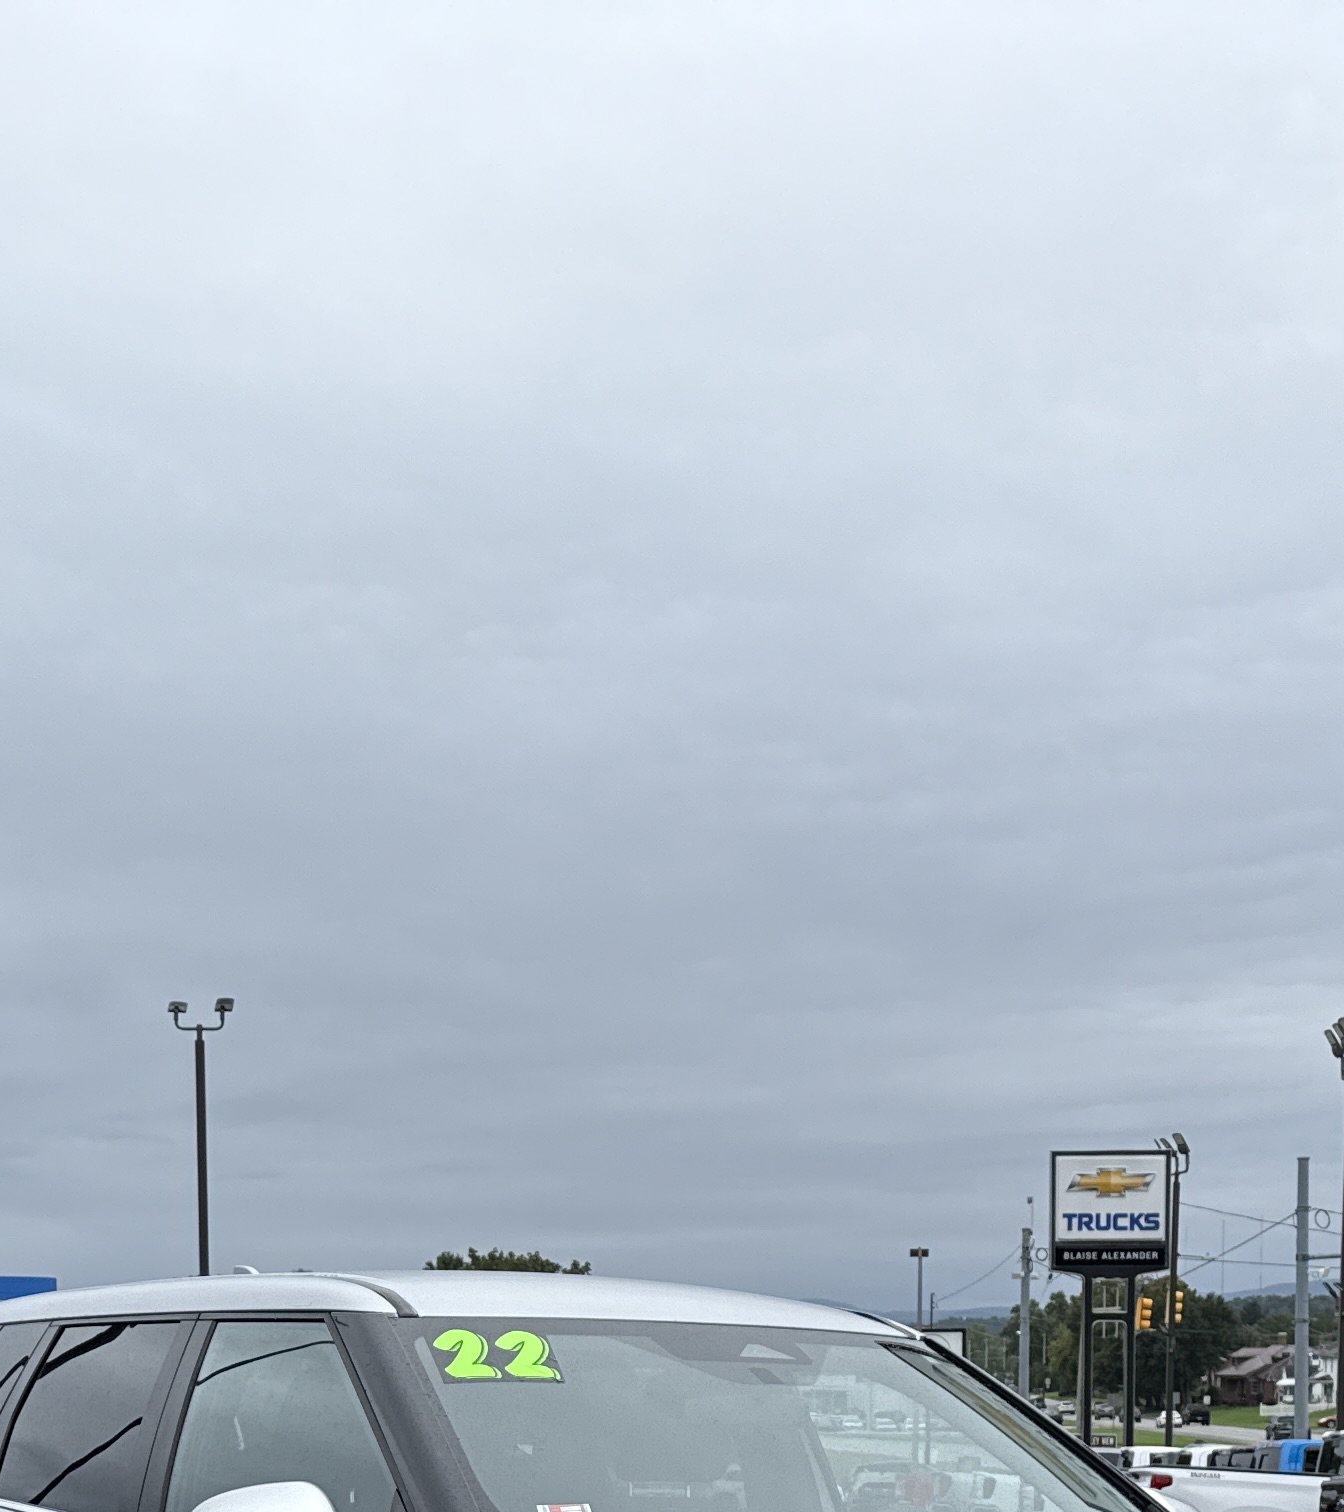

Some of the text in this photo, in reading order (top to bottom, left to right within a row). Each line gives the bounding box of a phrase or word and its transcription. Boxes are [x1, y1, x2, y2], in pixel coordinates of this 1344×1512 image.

[1062, 1212, 1160, 1232] TRUCKS
[1063, 1250, 1159, 1261] BLAISE ALEXANDER
[432, 1328, 562, 1381] 22
